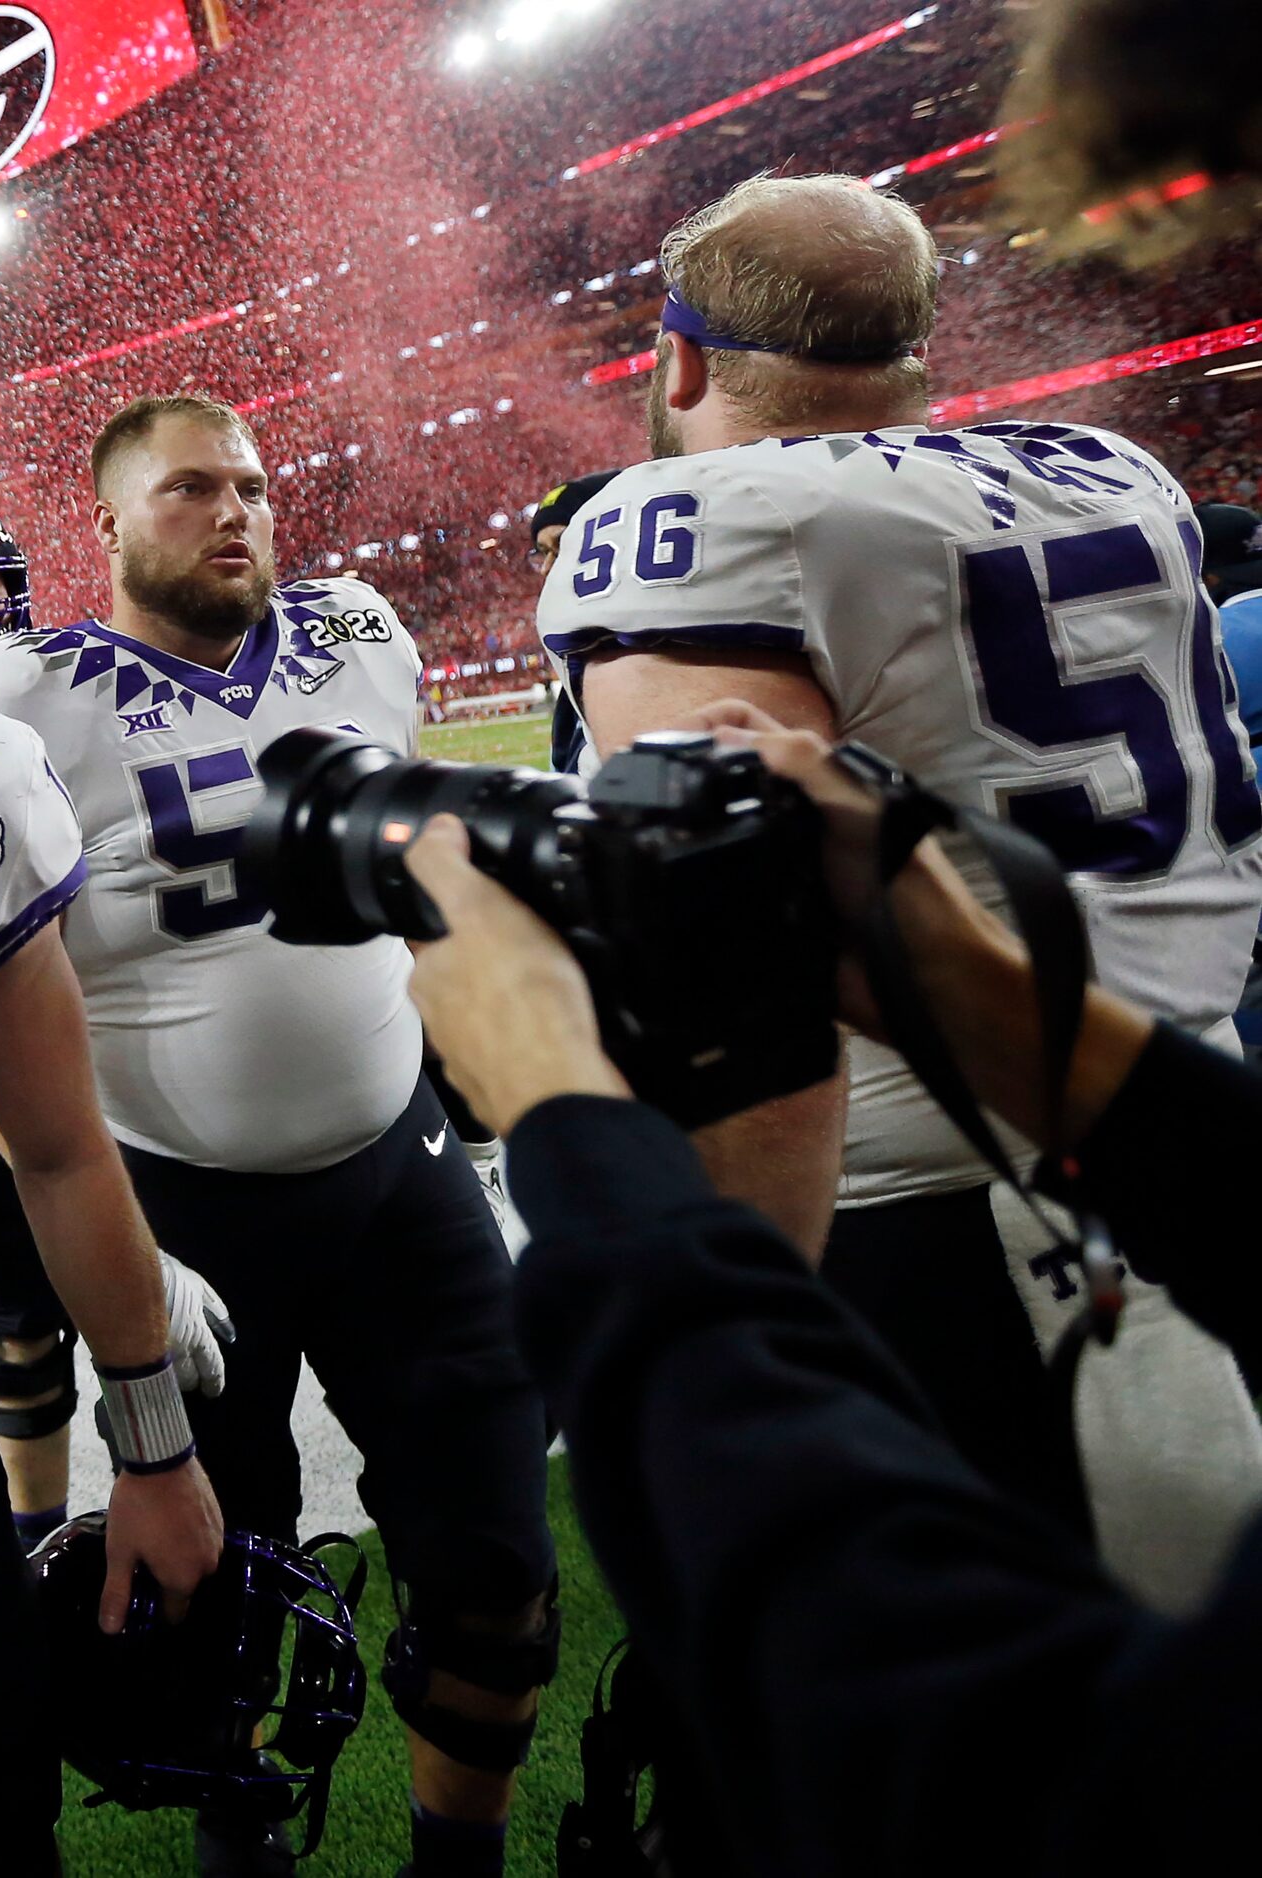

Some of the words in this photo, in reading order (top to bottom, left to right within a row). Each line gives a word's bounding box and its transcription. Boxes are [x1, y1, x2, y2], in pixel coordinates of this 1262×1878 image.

[572, 492, 701, 600] 56
[219, 685, 254, 704] TCU
[118, 705, 171, 737] XII
